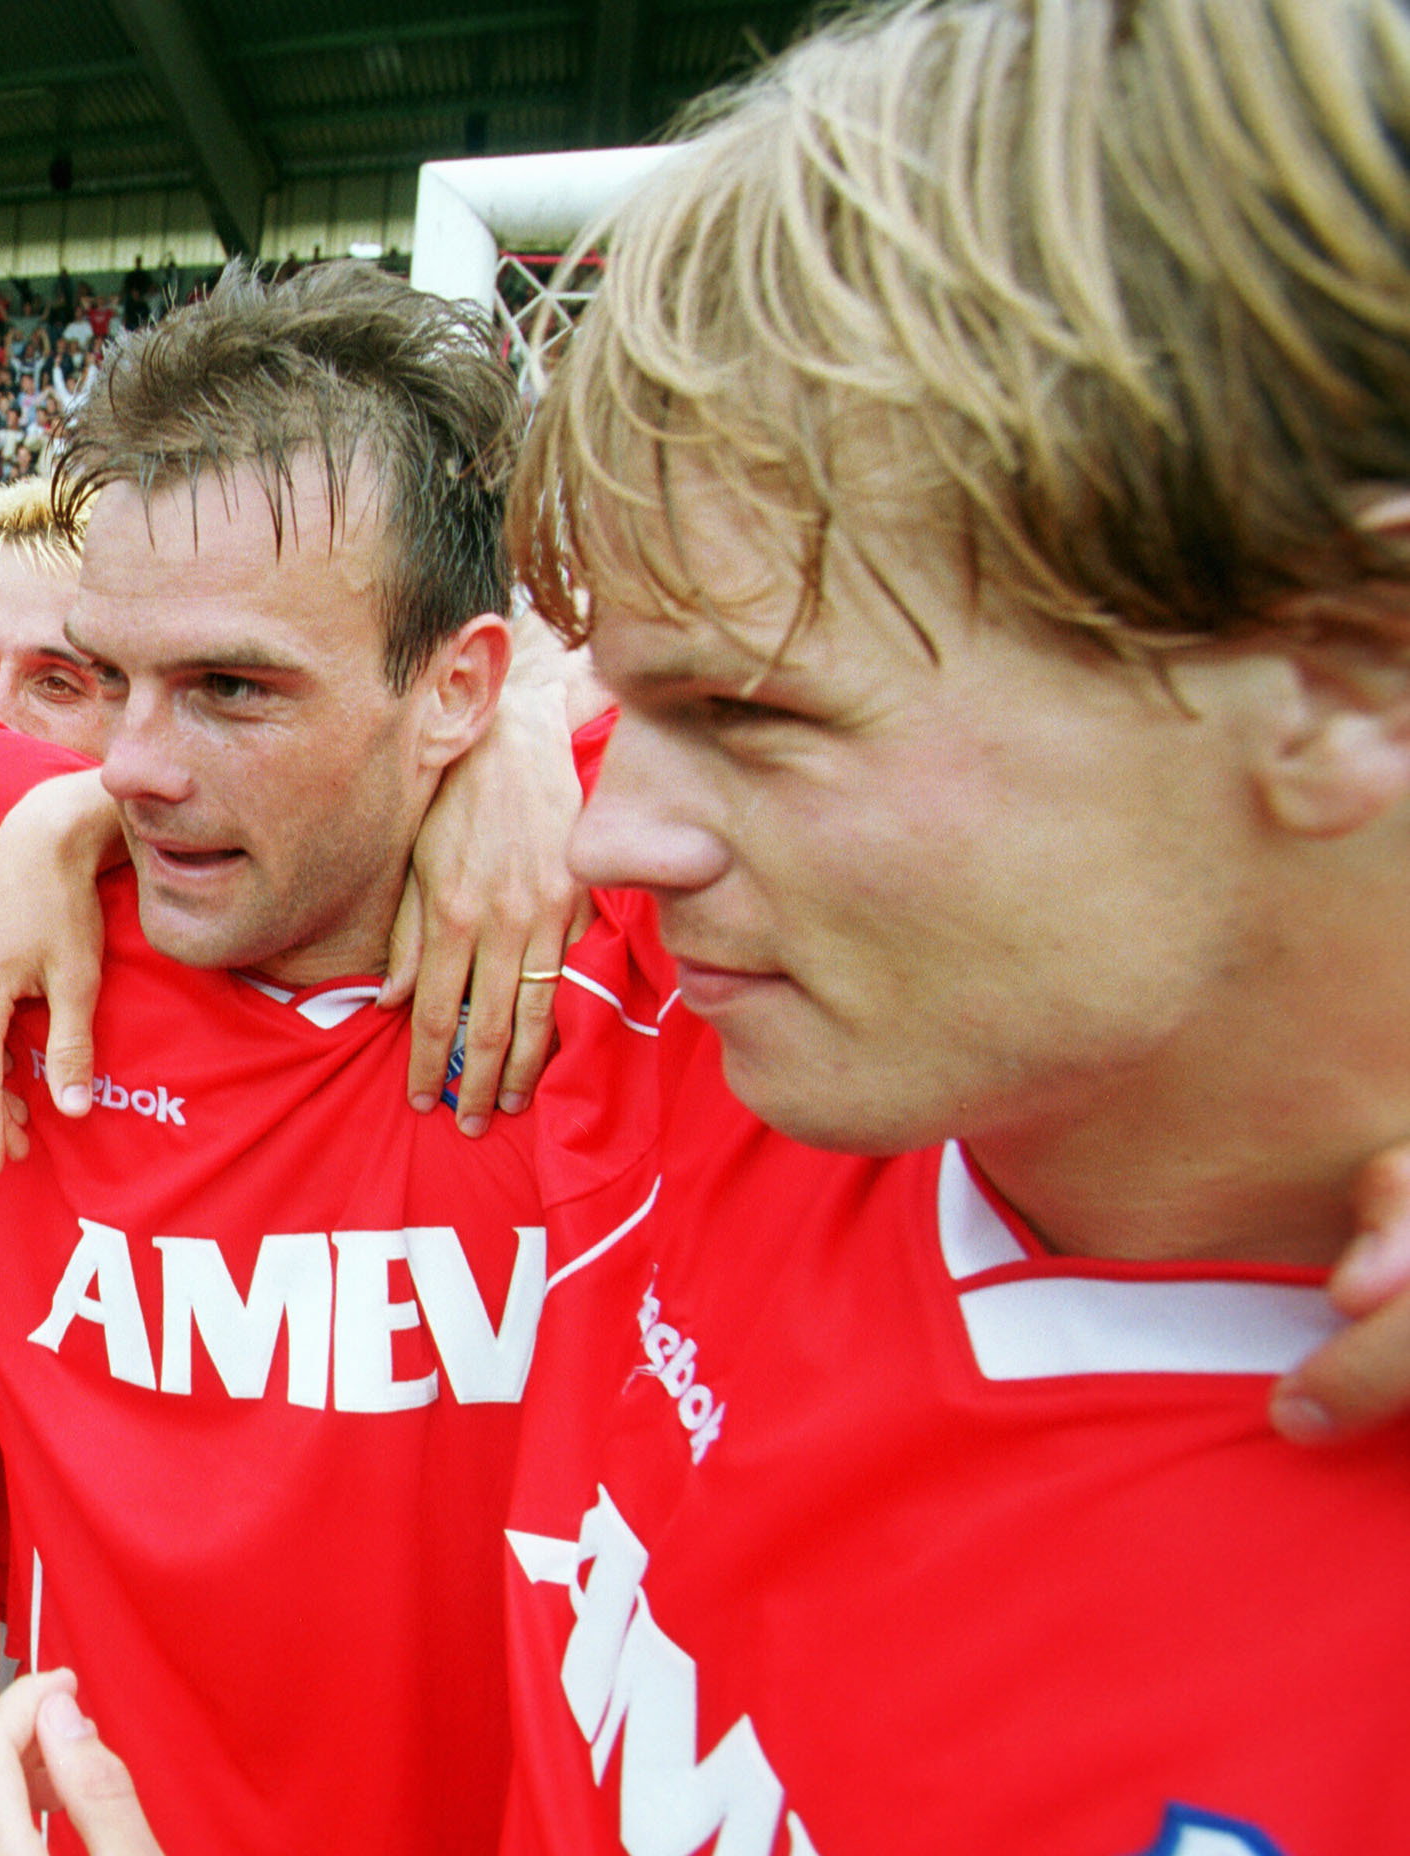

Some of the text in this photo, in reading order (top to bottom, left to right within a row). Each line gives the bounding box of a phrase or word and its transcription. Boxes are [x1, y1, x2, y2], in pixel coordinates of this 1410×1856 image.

[30, 1048, 187, 1126] Rbok
[27, 1217, 547, 1413] AMEV
[504, 1482, 821, 1856] AM
